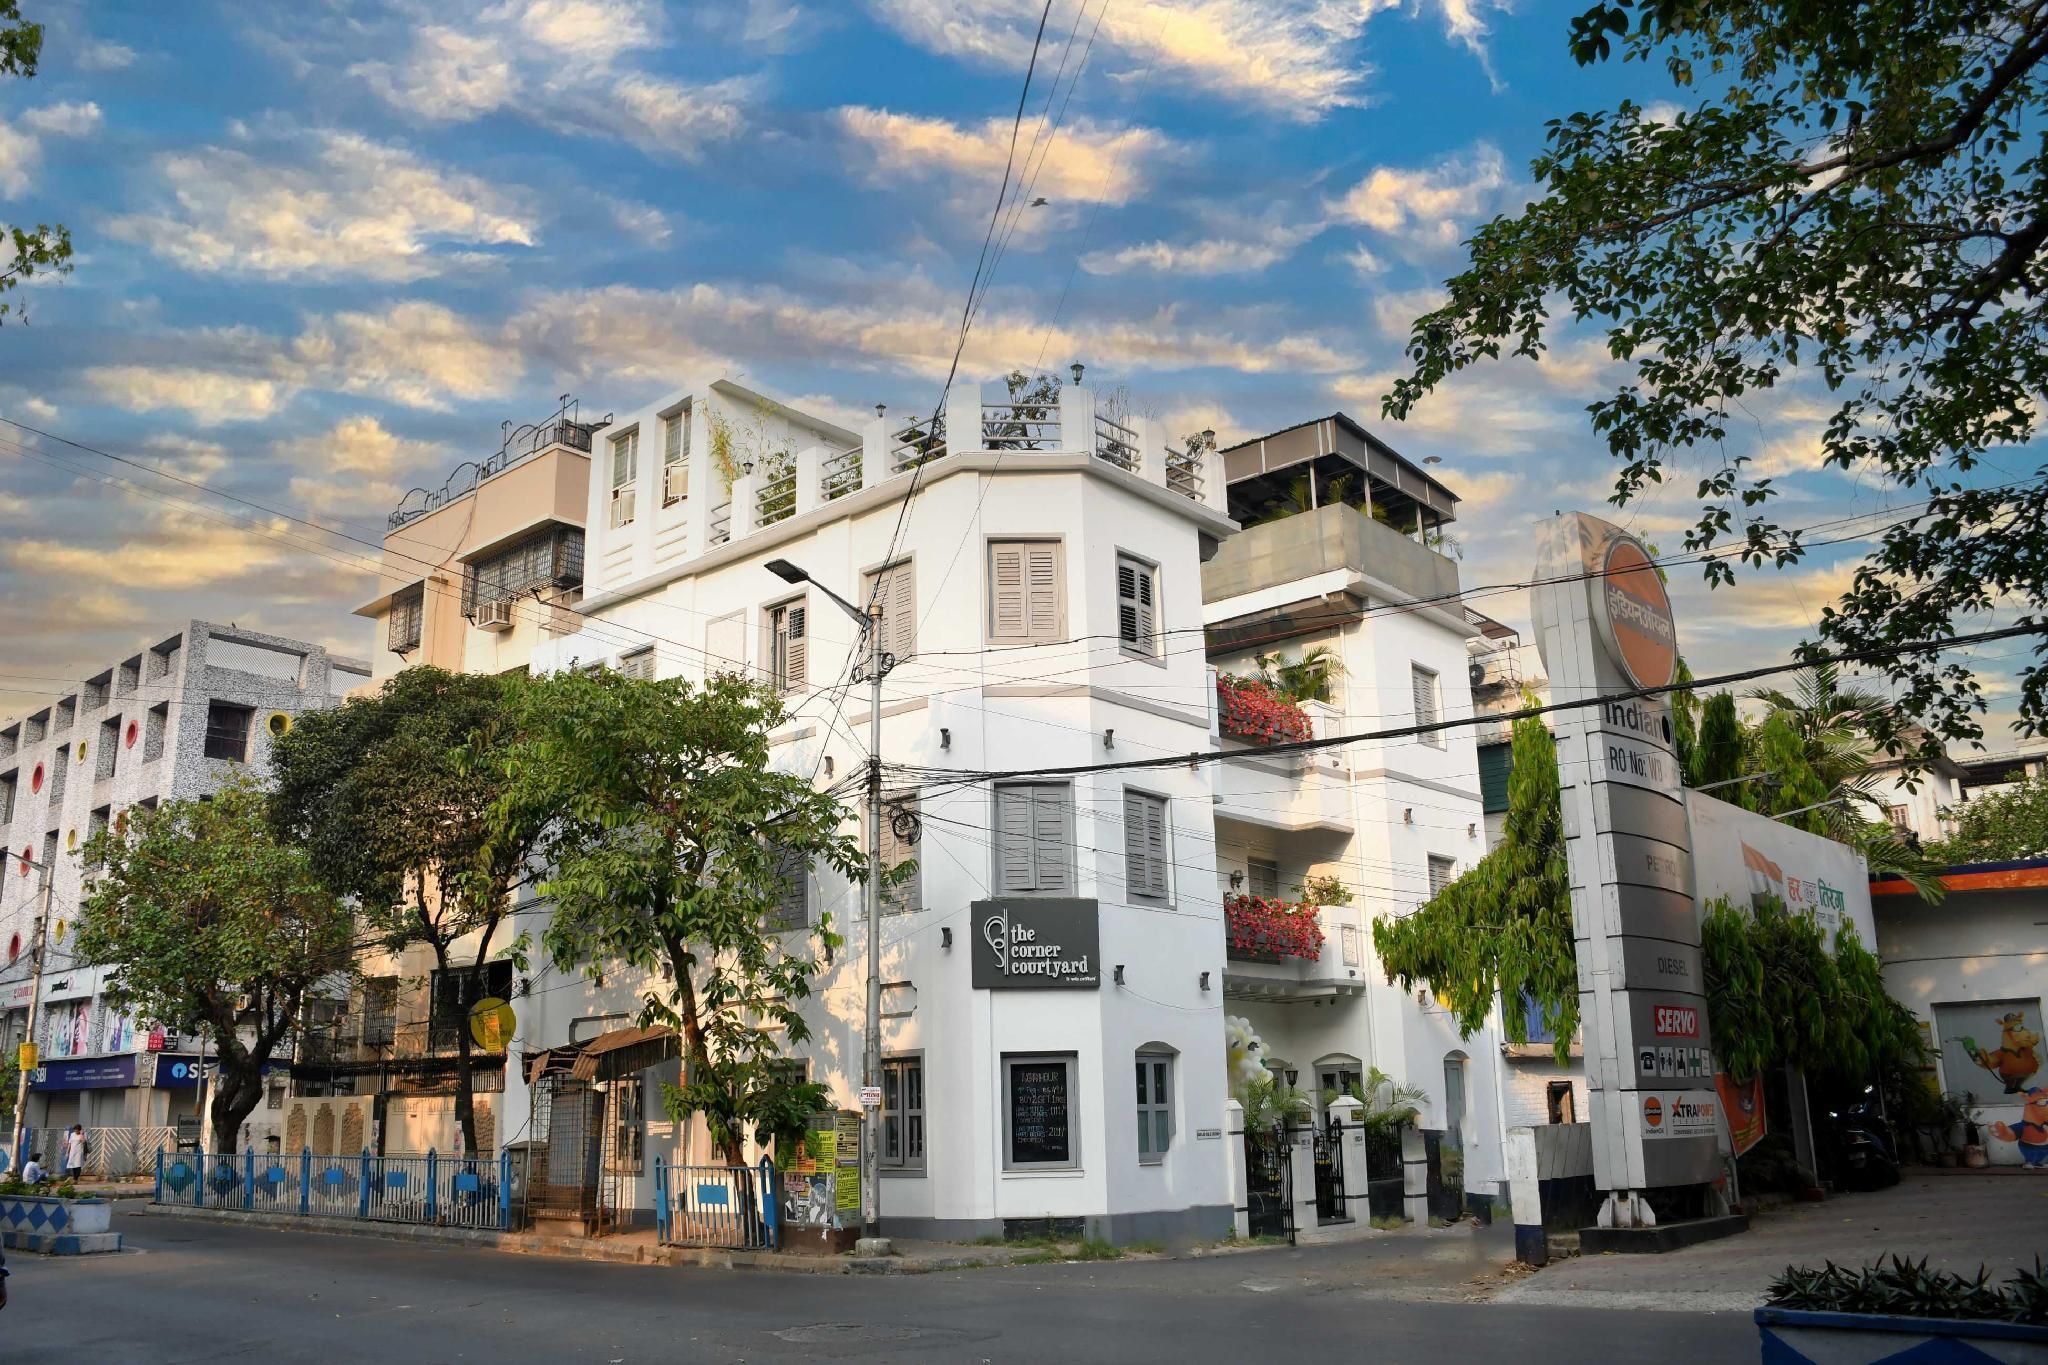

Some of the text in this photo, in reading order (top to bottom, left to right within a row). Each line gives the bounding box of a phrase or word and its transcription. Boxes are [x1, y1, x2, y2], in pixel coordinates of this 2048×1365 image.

[1609, 746, 1626, 772] RO
[1011, 924, 1035, 943] the
[1011, 945, 1061, 957] corner
[1011, 955, 1088, 978] courtyard
[1657, 957, 1689, 977] DIESEL
[1656, 1008, 1696, 1034] SERVO
[36, 1067, 47, 1083] SBI
